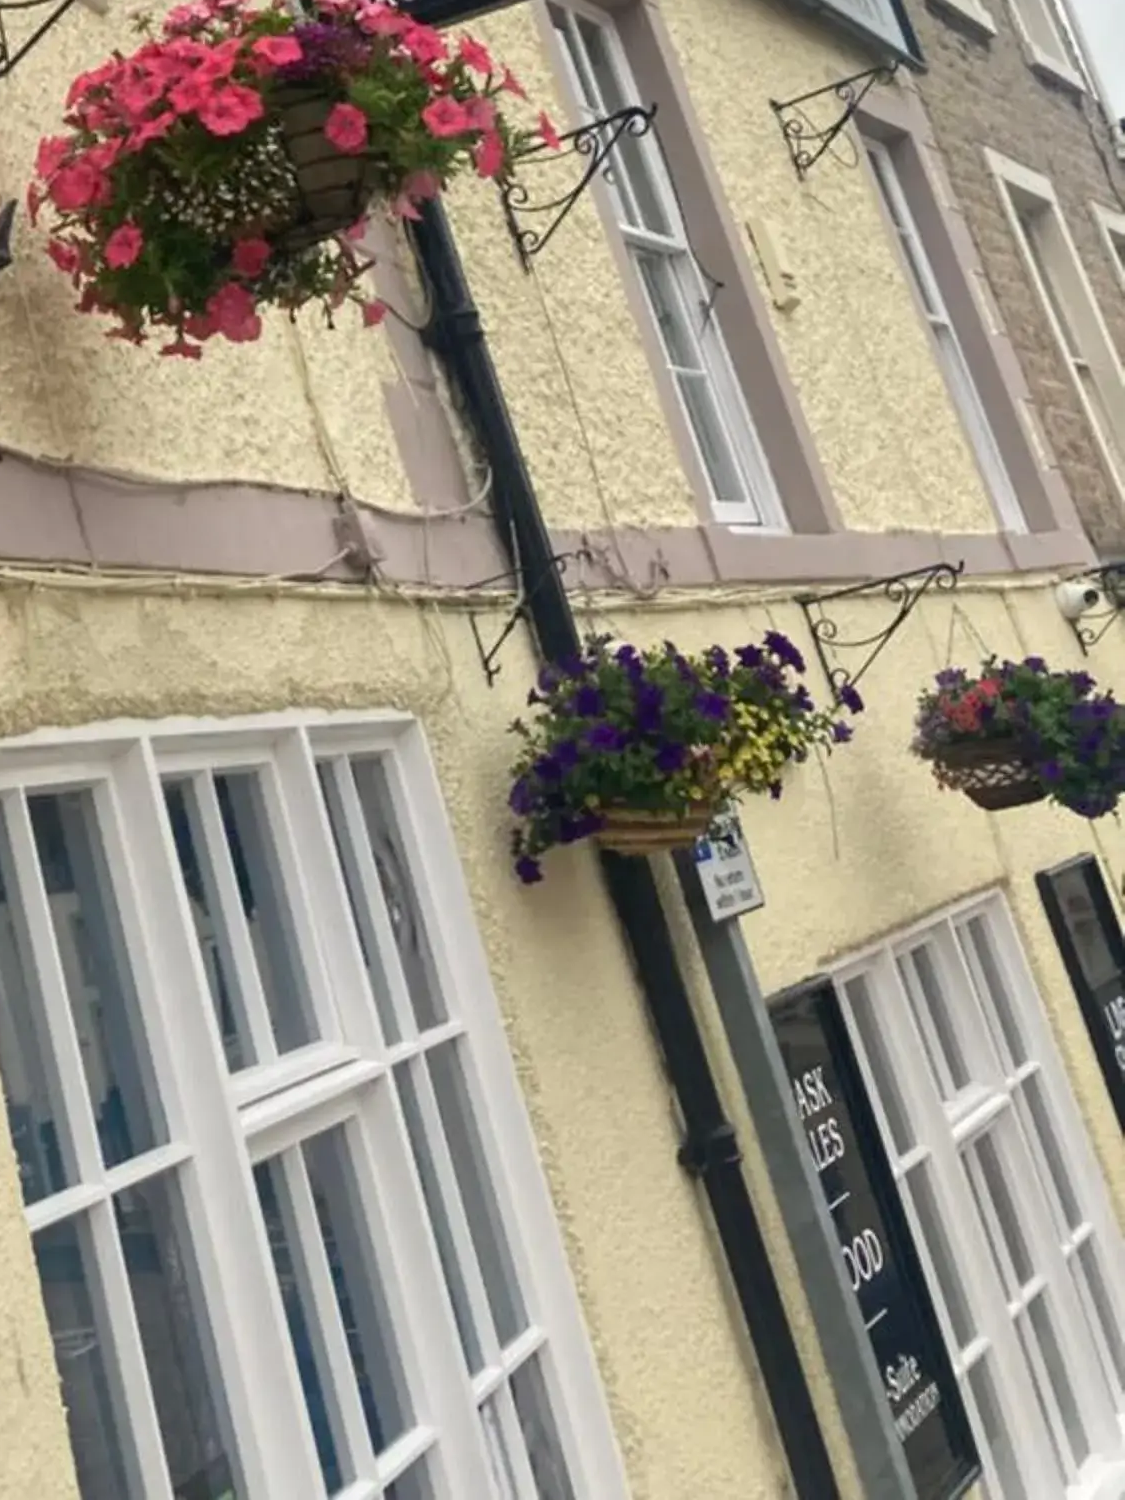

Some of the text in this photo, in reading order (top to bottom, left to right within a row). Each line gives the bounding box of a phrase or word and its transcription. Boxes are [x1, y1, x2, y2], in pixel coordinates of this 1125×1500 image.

[793, 1066, 833, 1120] ASK
[808, 1117, 845, 1173] LES
[842, 1227, 884, 1292] OOD
